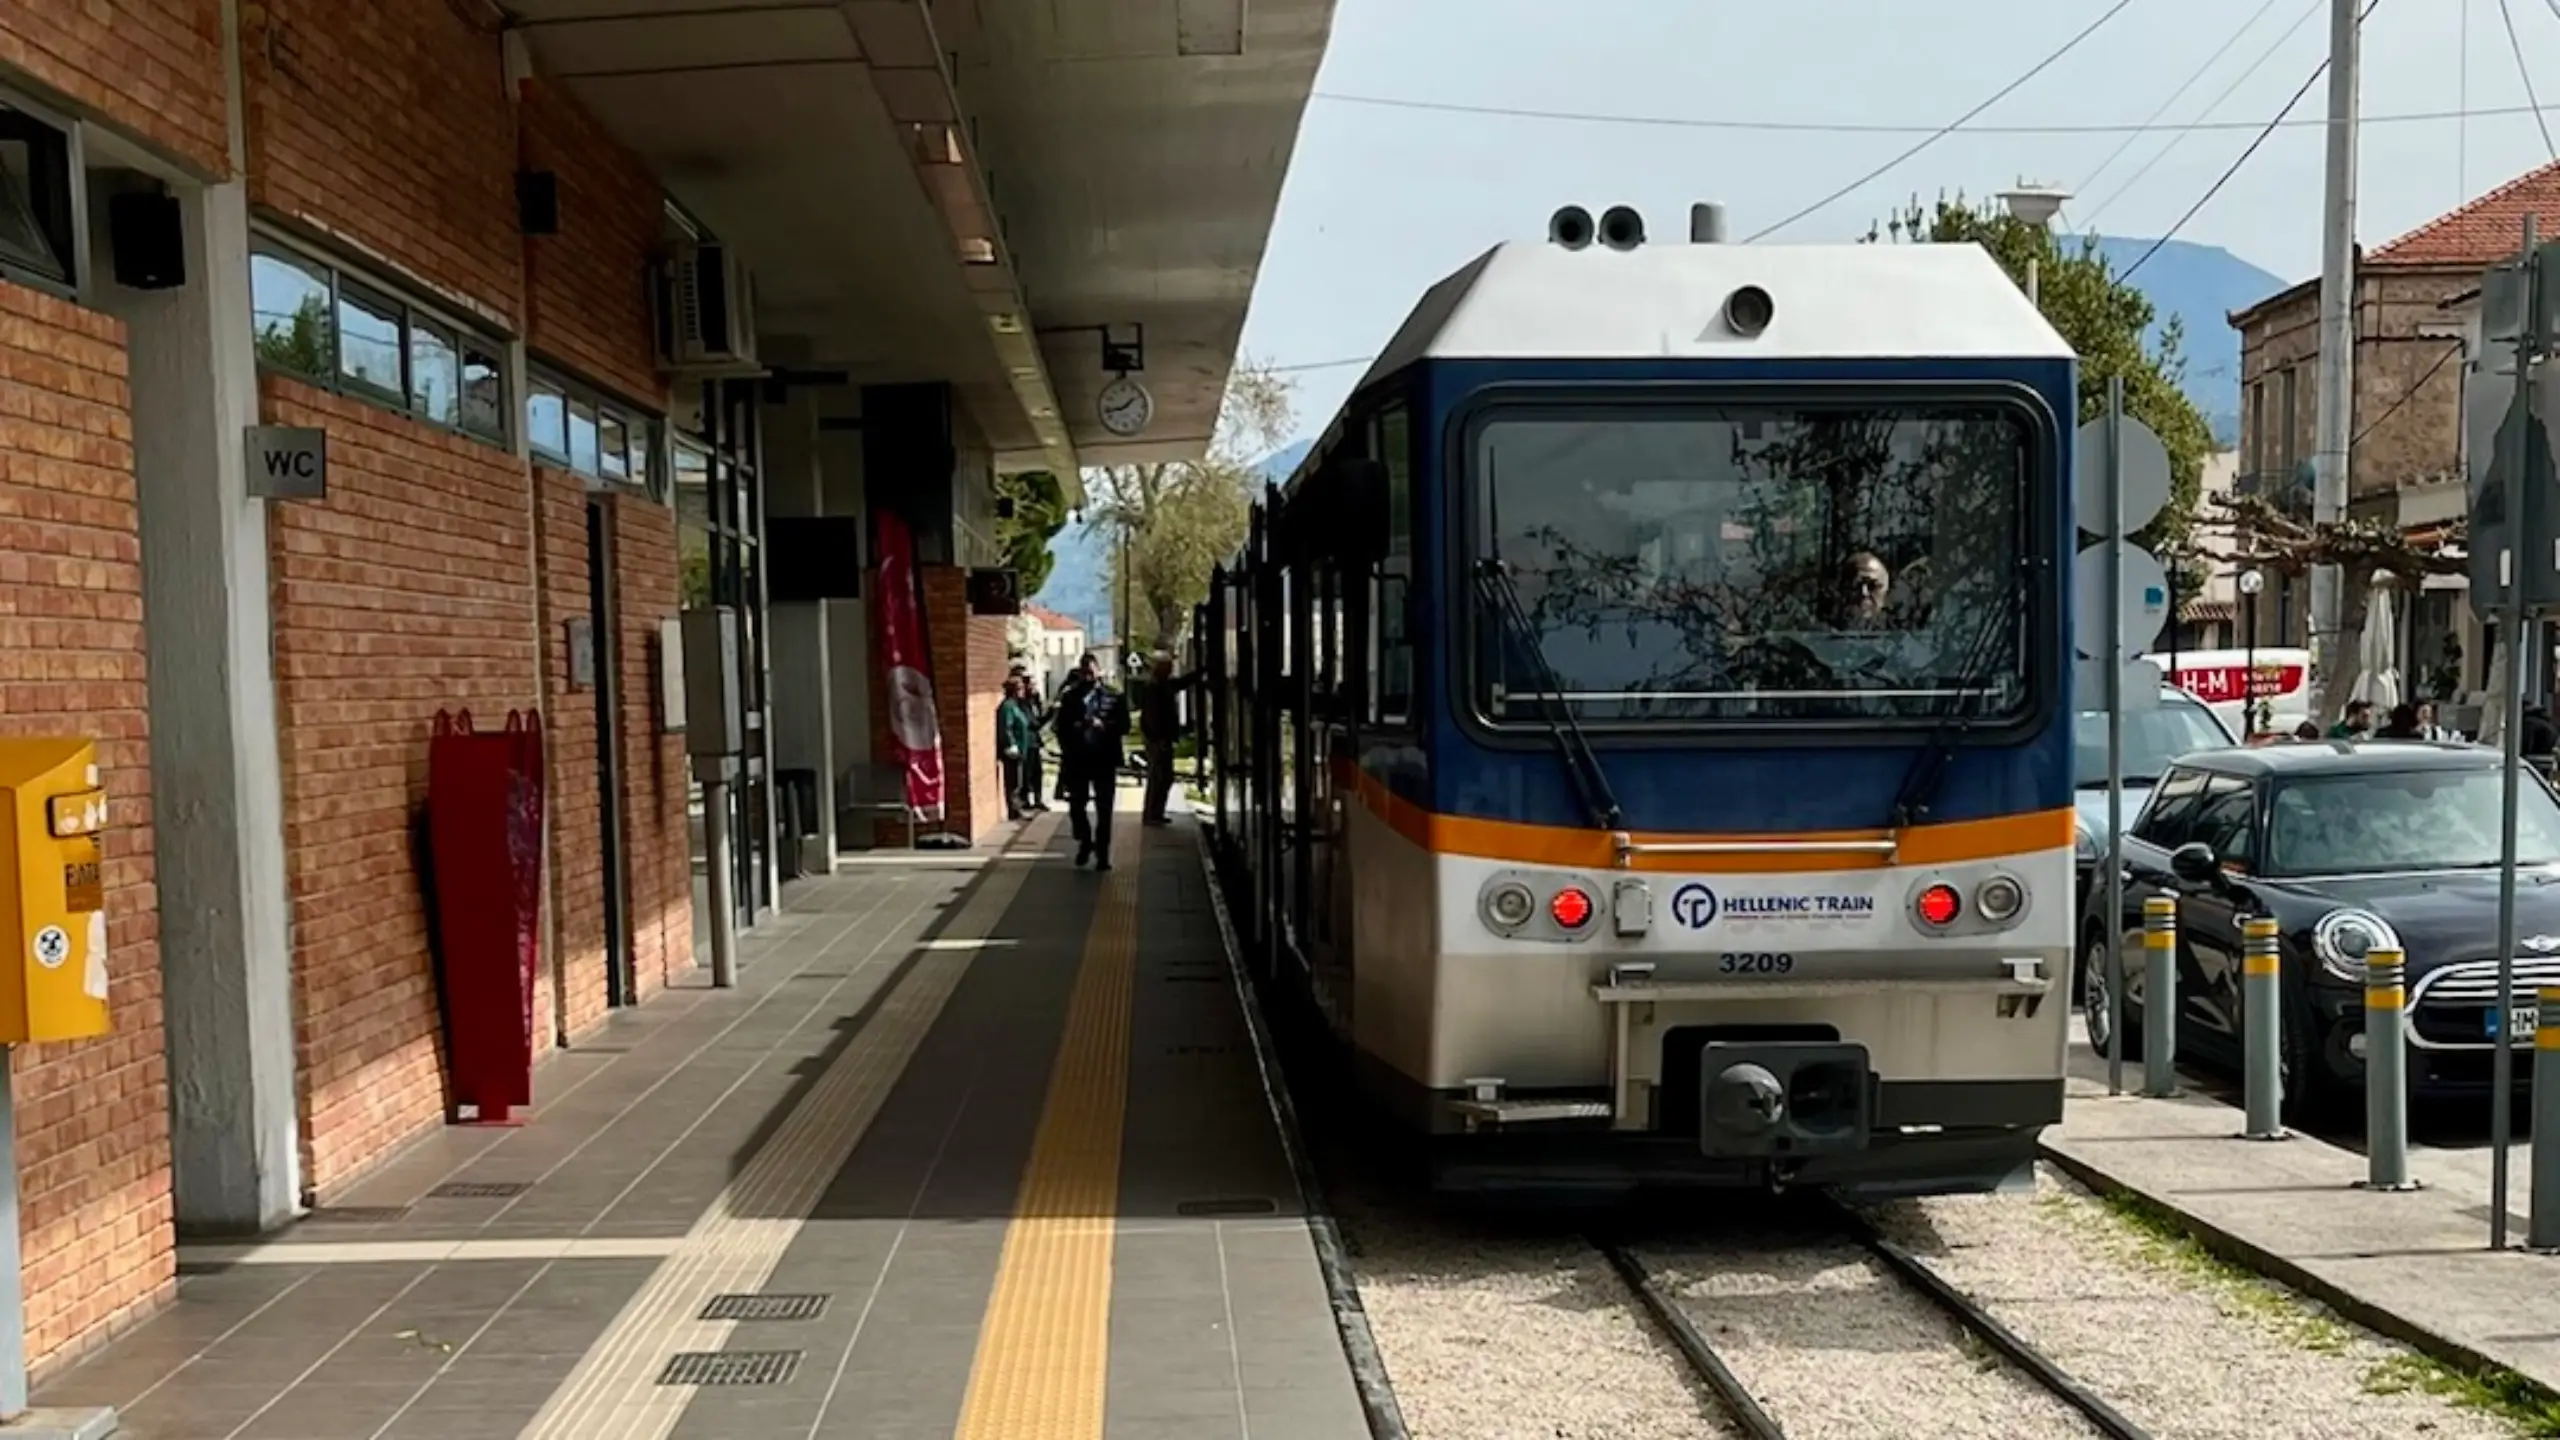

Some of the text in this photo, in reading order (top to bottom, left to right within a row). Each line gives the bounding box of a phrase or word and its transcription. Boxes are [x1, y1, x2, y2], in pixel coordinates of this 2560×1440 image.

[264, 450, 315, 478] WC
[1723, 895, 1874, 913] HELLENIC TRAIN
[1719, 952, 1794, 974] 3209
